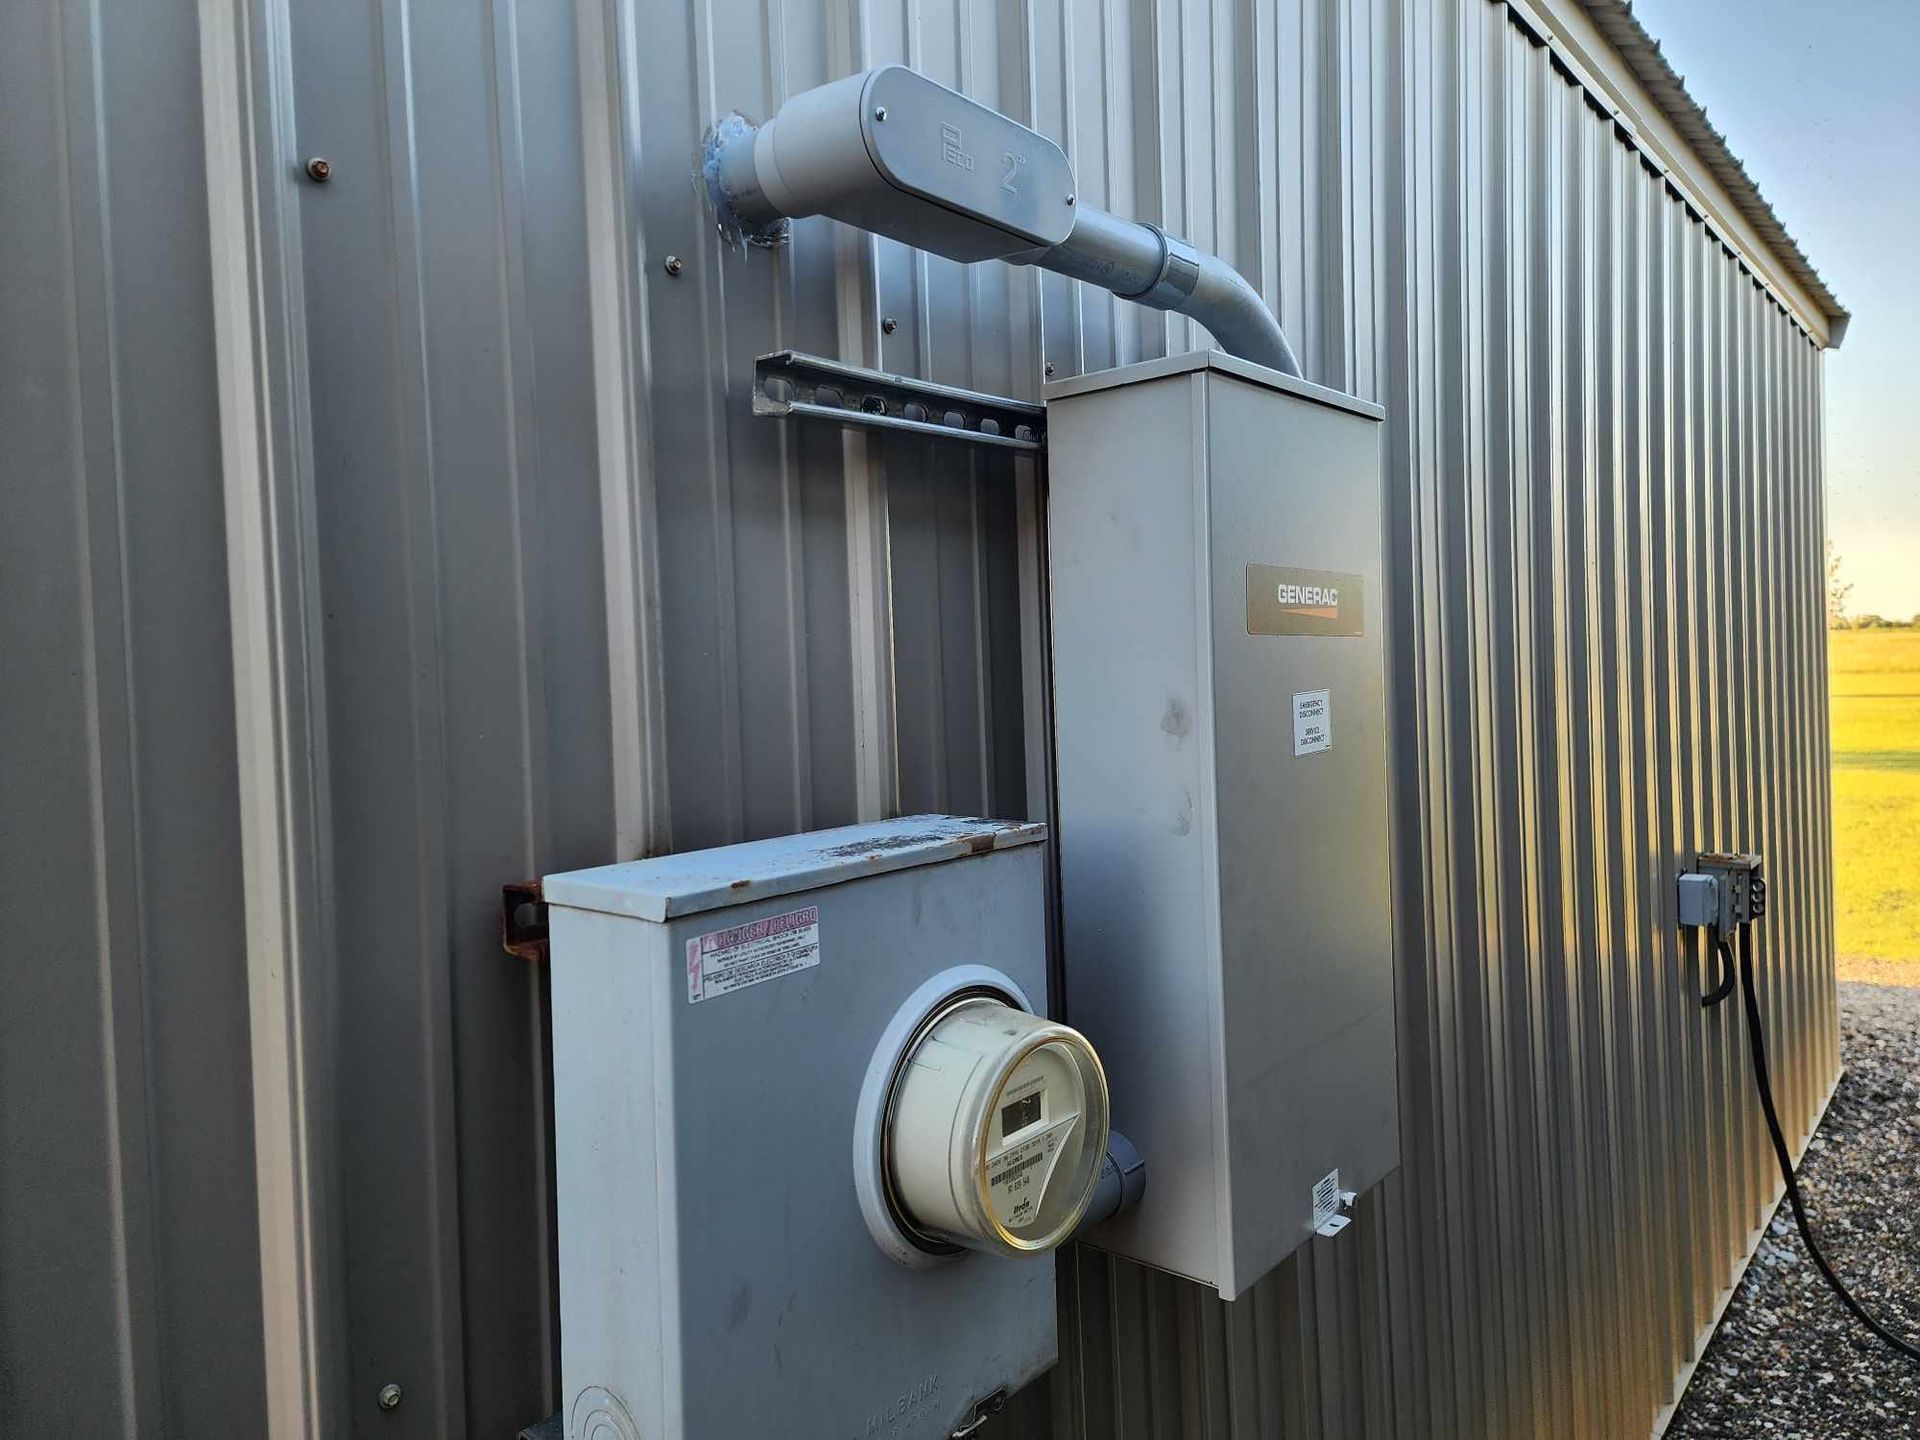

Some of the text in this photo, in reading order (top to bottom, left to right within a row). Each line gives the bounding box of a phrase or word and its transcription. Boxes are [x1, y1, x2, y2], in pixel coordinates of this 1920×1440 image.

[1278, 583, 1339, 607] GENERAC
[1299, 708, 1324, 719] DISCONNECT
[1300, 734, 1325, 746] DISCONNECT
[718, 923, 762, 947] DANGER
